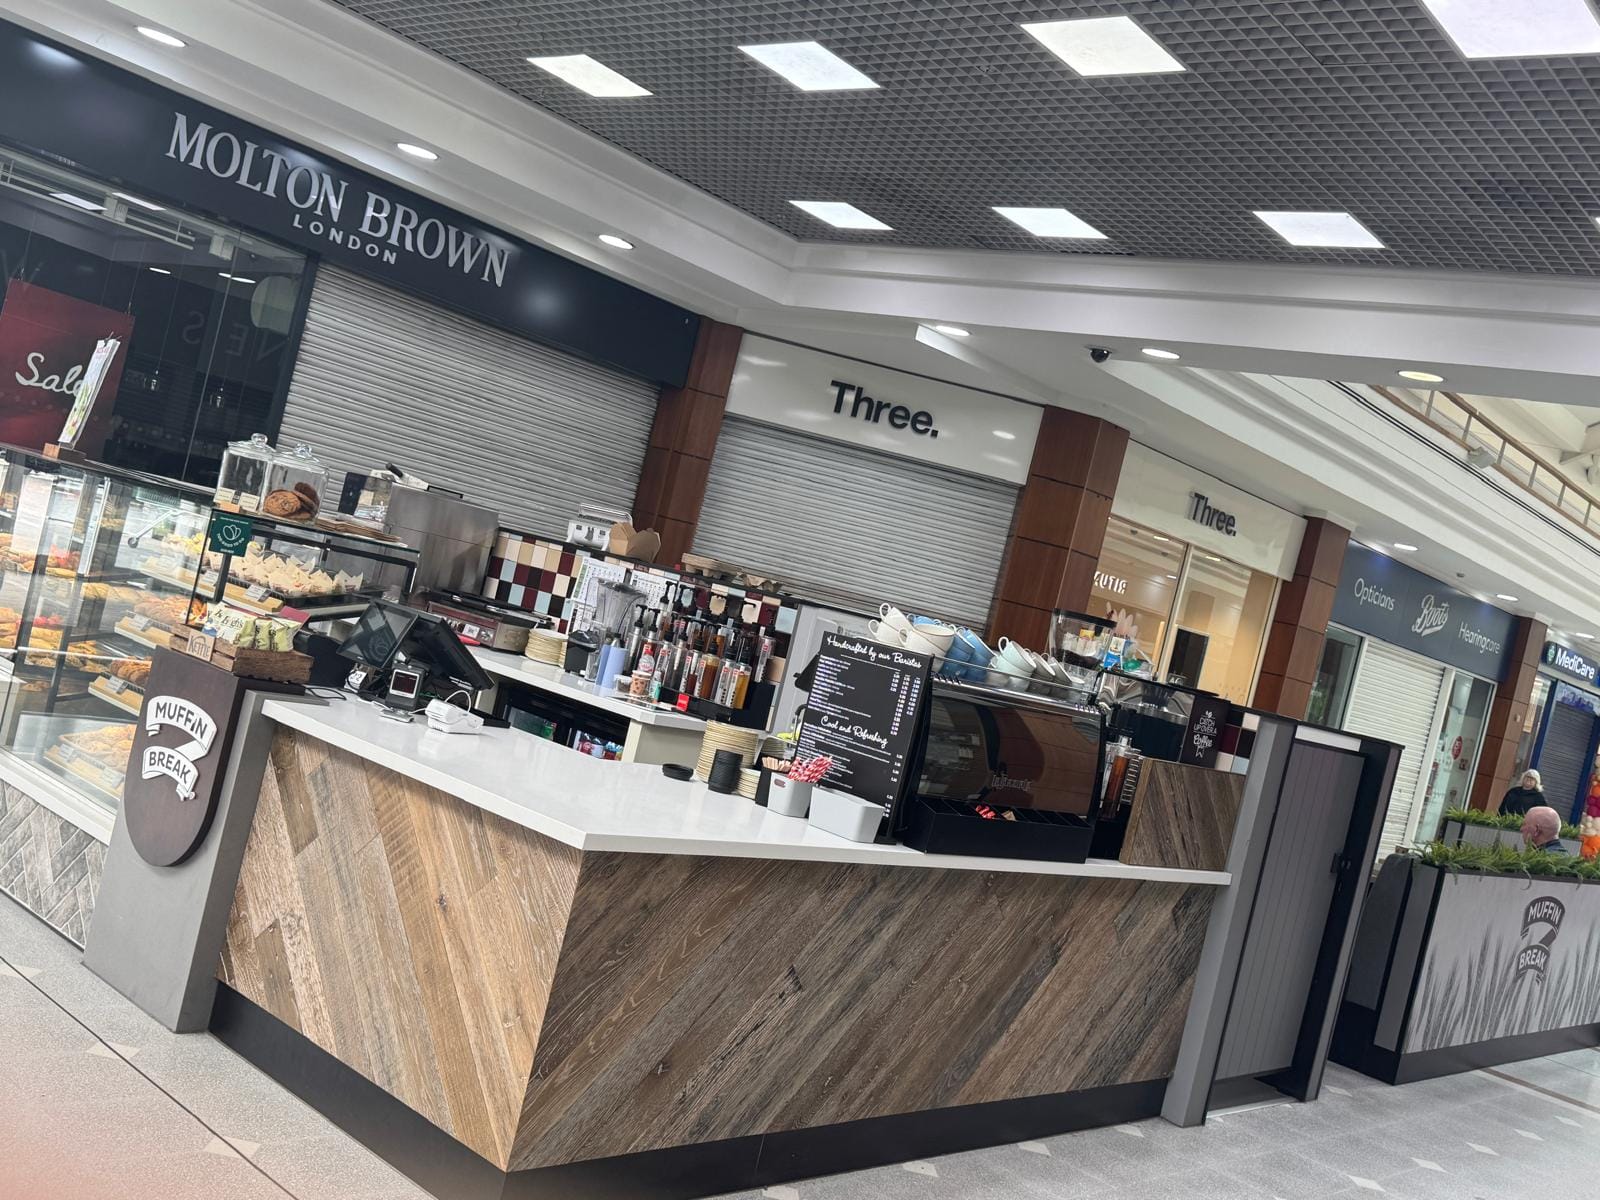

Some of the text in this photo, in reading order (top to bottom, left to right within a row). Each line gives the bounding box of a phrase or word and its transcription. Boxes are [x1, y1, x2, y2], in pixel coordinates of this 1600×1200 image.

[166, 112, 512, 288] MOLTON BROWN
[292, 212, 398, 265] LONDON
[830, 379, 939, 438] Three.
[1193, 492, 1237, 537] Three.
[1354, 577, 1396, 612] Opticians
[1412, 594, 1450, 637] Boots
[190, 635, 211, 656] KETTLE
[827, 635, 922, 668] Handcrafted by our Baristas
[1458, 620, 1500, 656] Hearingcare
[1555, 647, 1595, 680] MediCare
[820, 715, 888, 749] Cool and Refreshing
[1194, 723, 1201, 731] UP
[1201, 725, 1213, 733] OVER
[1199, 717, 1216, 727] CATCH
[148, 750, 190, 785] BREAK
[1527, 901, 1563, 925] MUFFIN
[1519, 948, 1548, 970] BREAK
